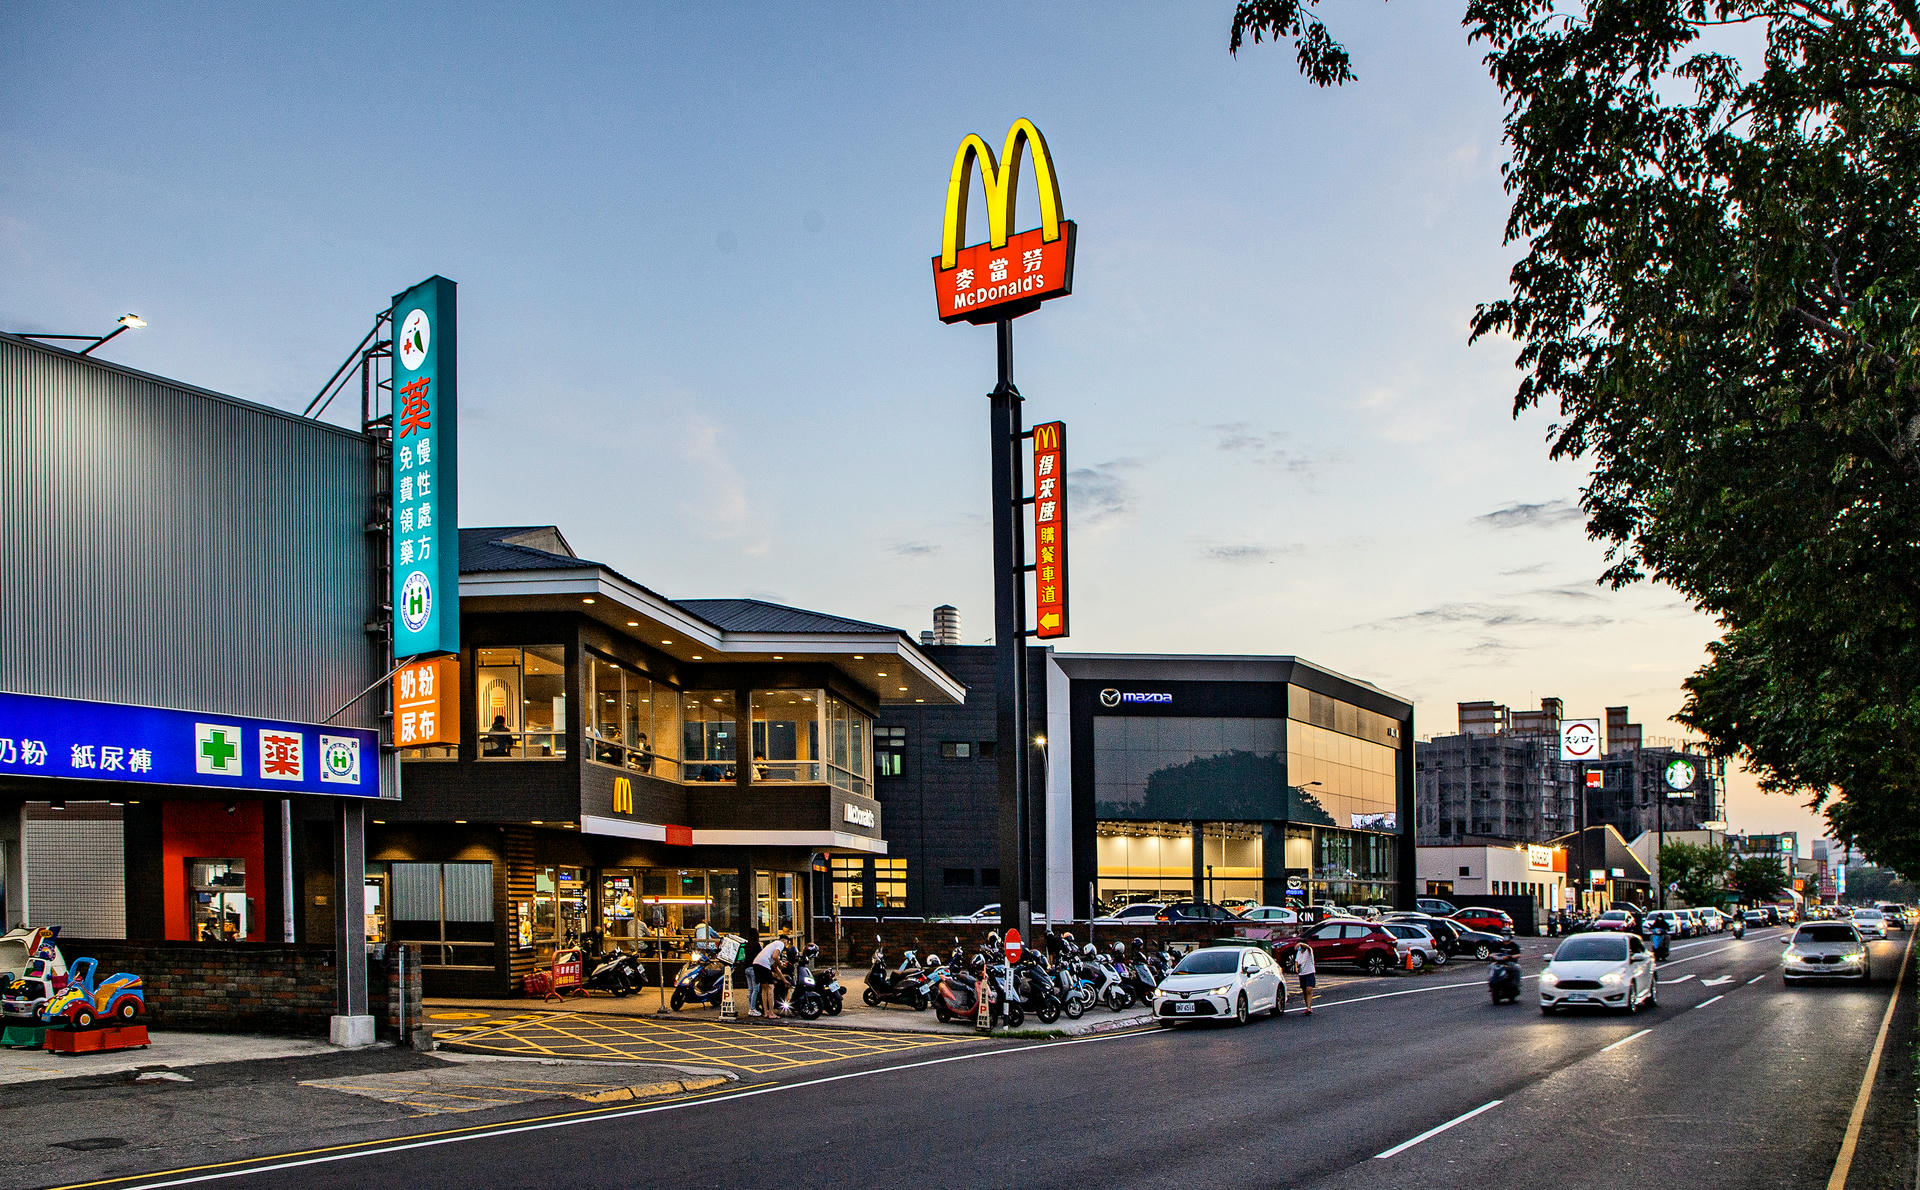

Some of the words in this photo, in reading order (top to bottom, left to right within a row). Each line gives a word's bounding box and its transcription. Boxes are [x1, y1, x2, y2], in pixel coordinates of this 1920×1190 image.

[956, 248, 1043, 292] 麥當勞
[954, 273, 1045, 310] McDonald's
[399, 445, 414, 566] 免費領藥
[416, 438, 432, 562] 慢性處方
[1037, 454, 1056, 523] 得來速
[1040, 526, 1056, 604] 購餐車道
[400, 665, 435, 701] 奶粉
[1123, 692, 1173, 703] mazda
[400, 709, 436, 743] 尿布
[1564, 735, 1597, 744] スシロー
[70, 743, 153, 774] 紙尿褲
[1304, 911, 1315, 922] IN
[980, 1005, 987, 1014] P
